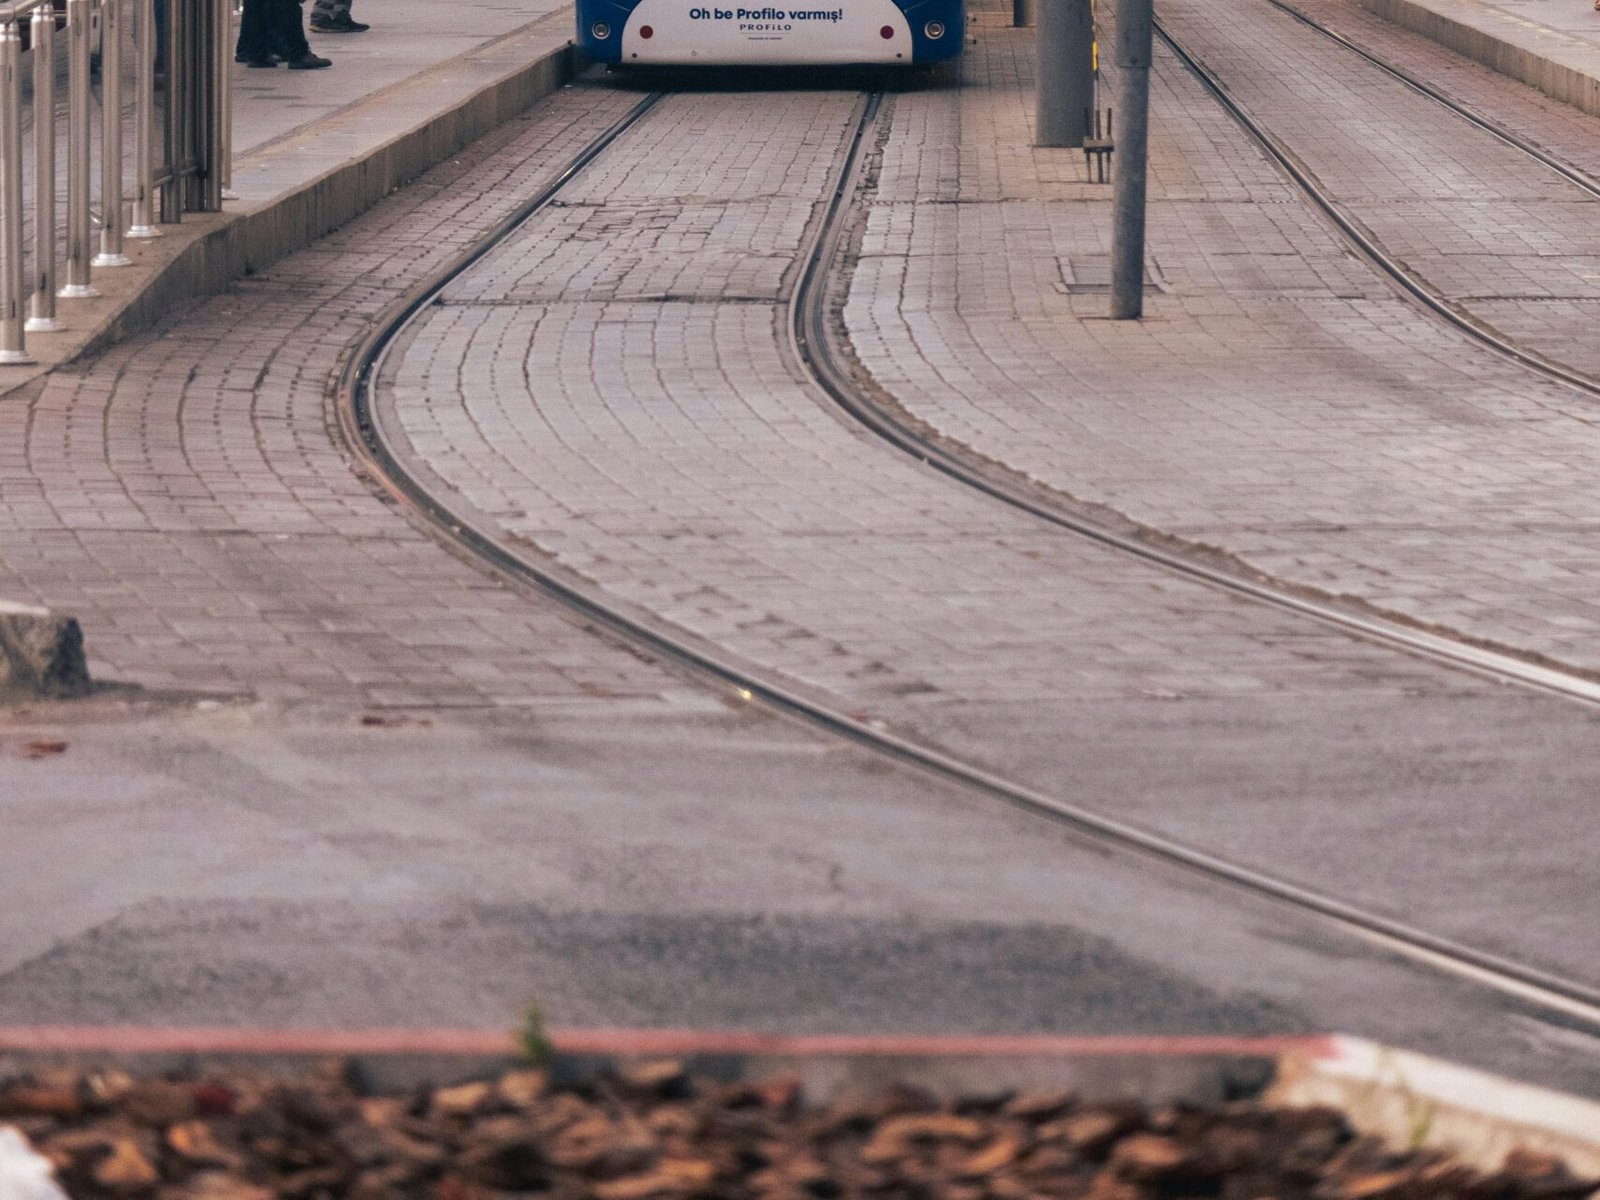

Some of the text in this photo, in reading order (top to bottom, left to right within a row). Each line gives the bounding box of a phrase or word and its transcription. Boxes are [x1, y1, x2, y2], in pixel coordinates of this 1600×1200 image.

[689, 8, 843, 23] Oh be Profilo varmış!
